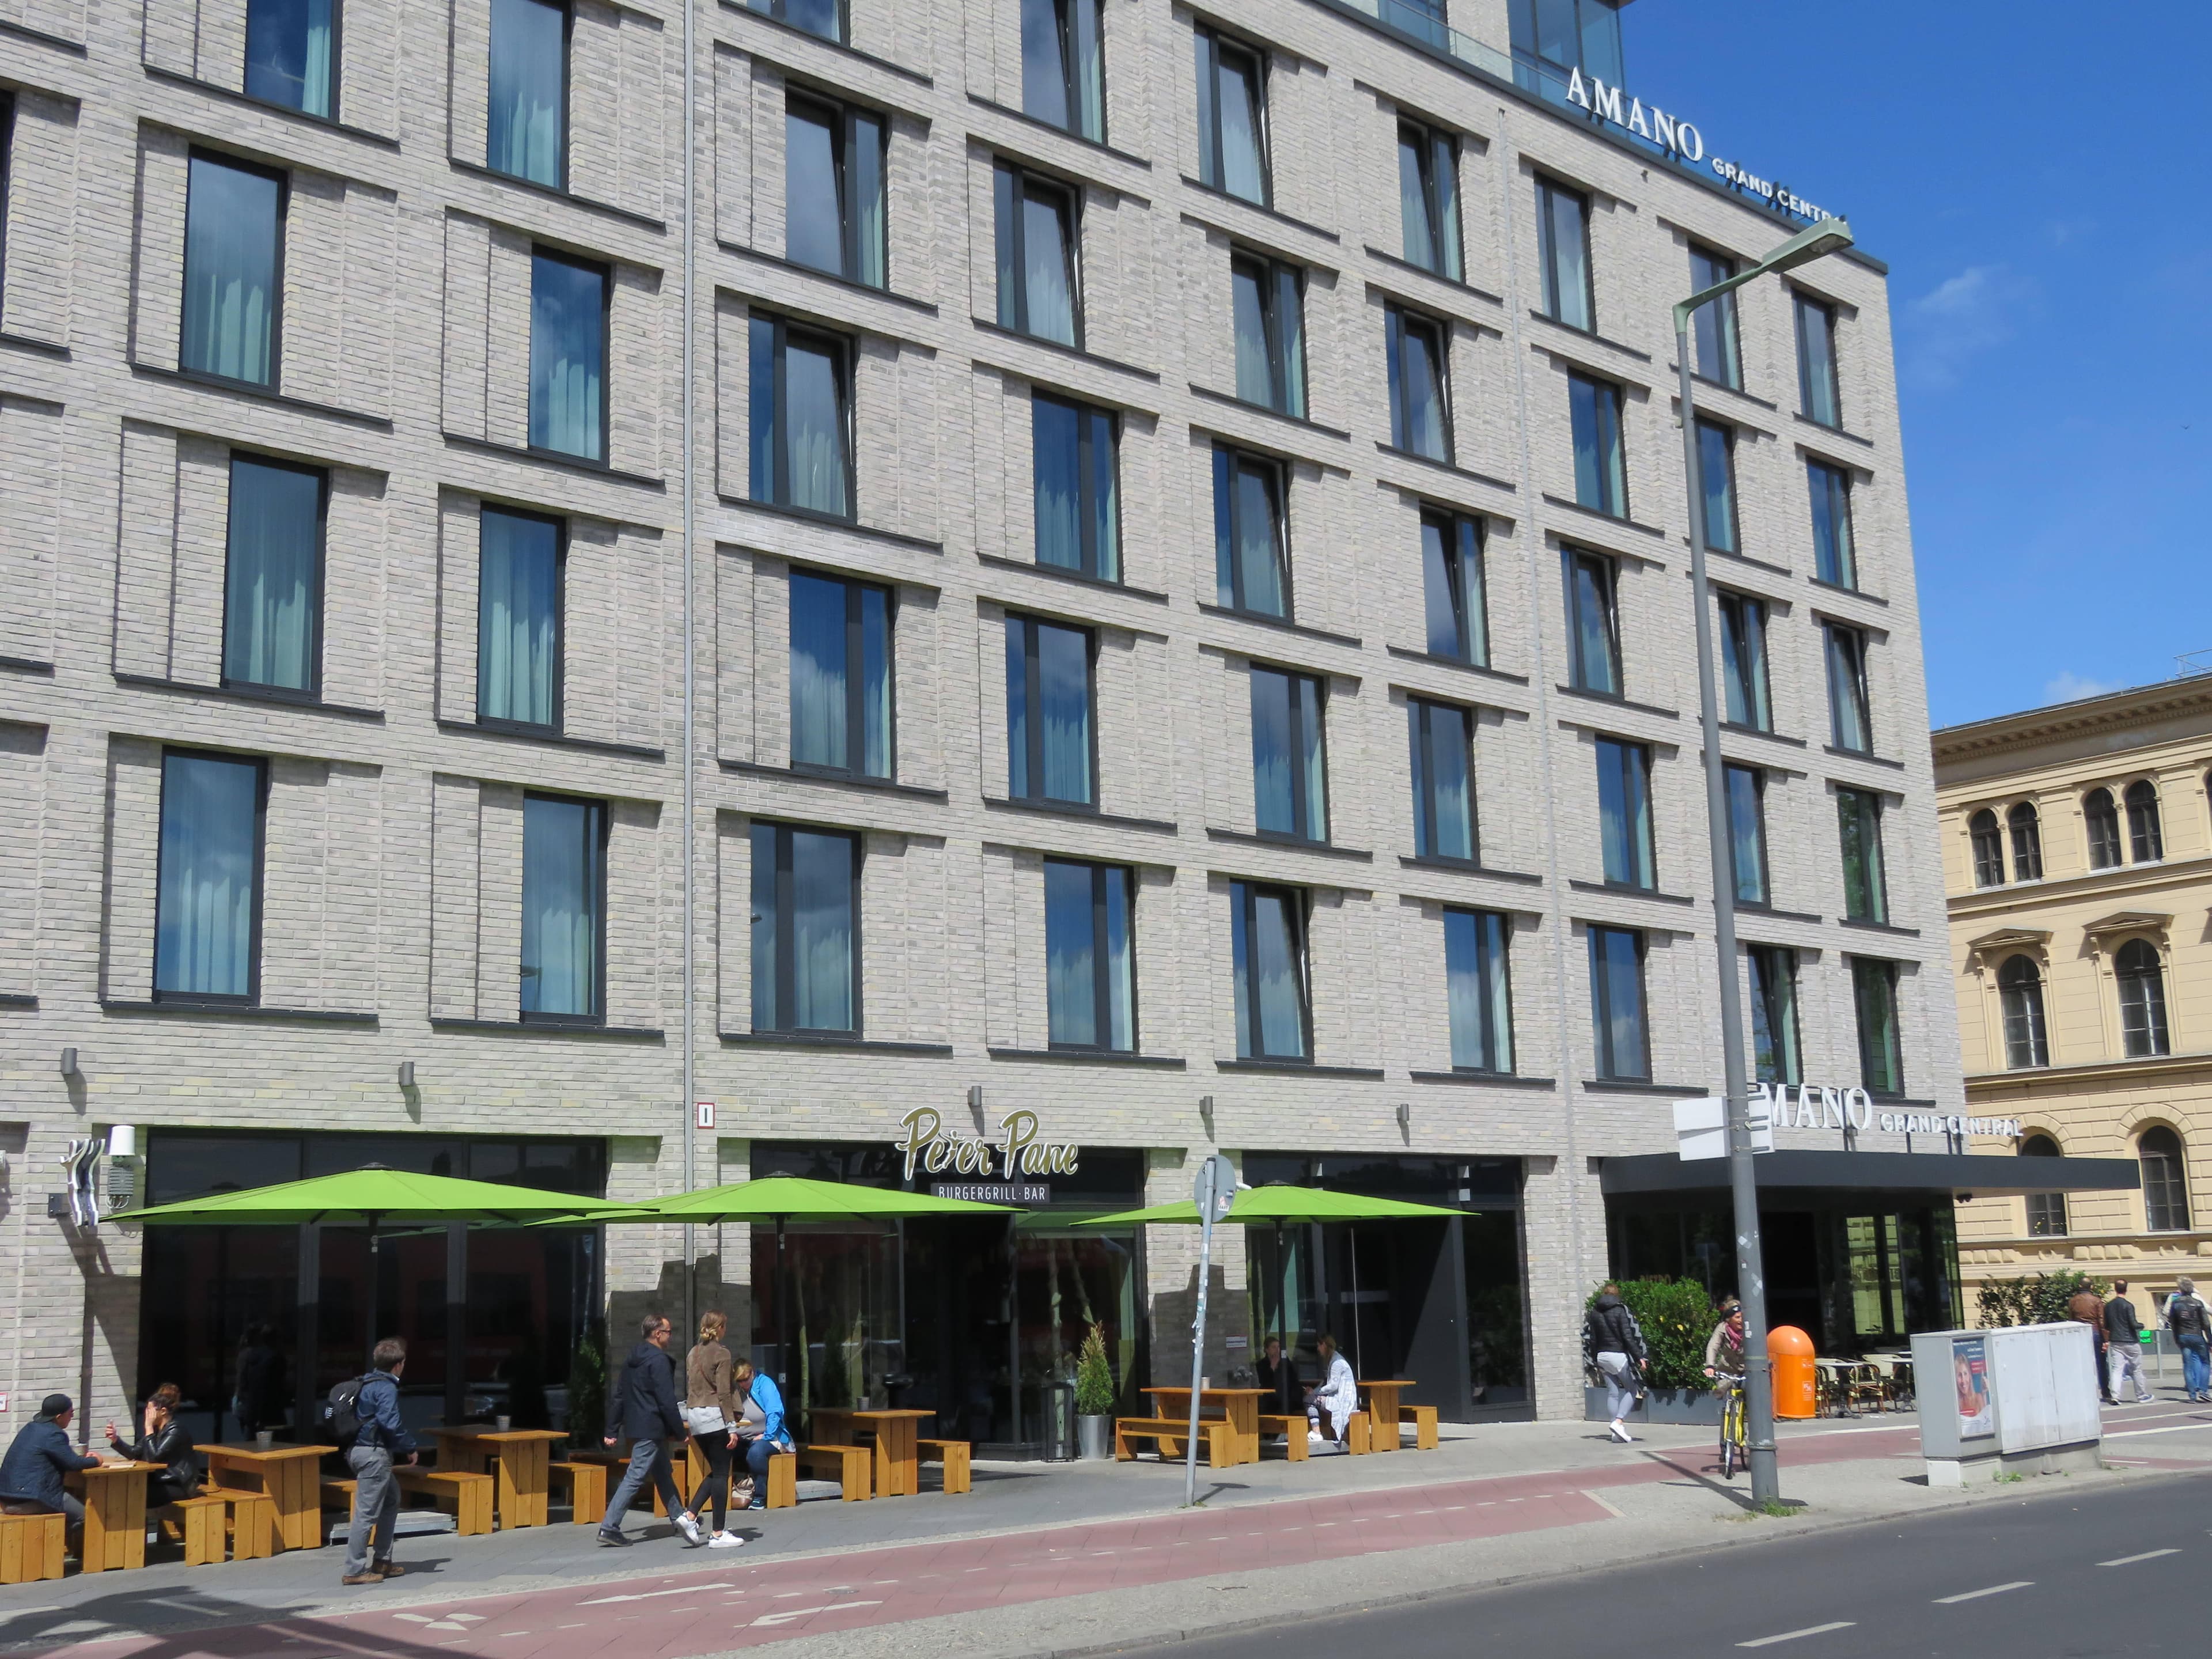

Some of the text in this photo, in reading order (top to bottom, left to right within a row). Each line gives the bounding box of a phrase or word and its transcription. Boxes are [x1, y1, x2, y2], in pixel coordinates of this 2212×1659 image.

[1565, 66, 1847, 224] AMANO GRAND CENTR
[1756, 1082, 2024, 1137] MANO GRAND CENTRAL
[895, 1105, 1079, 1181] Peter Pane
[1024, 1187, 1045, 1200] BAR
